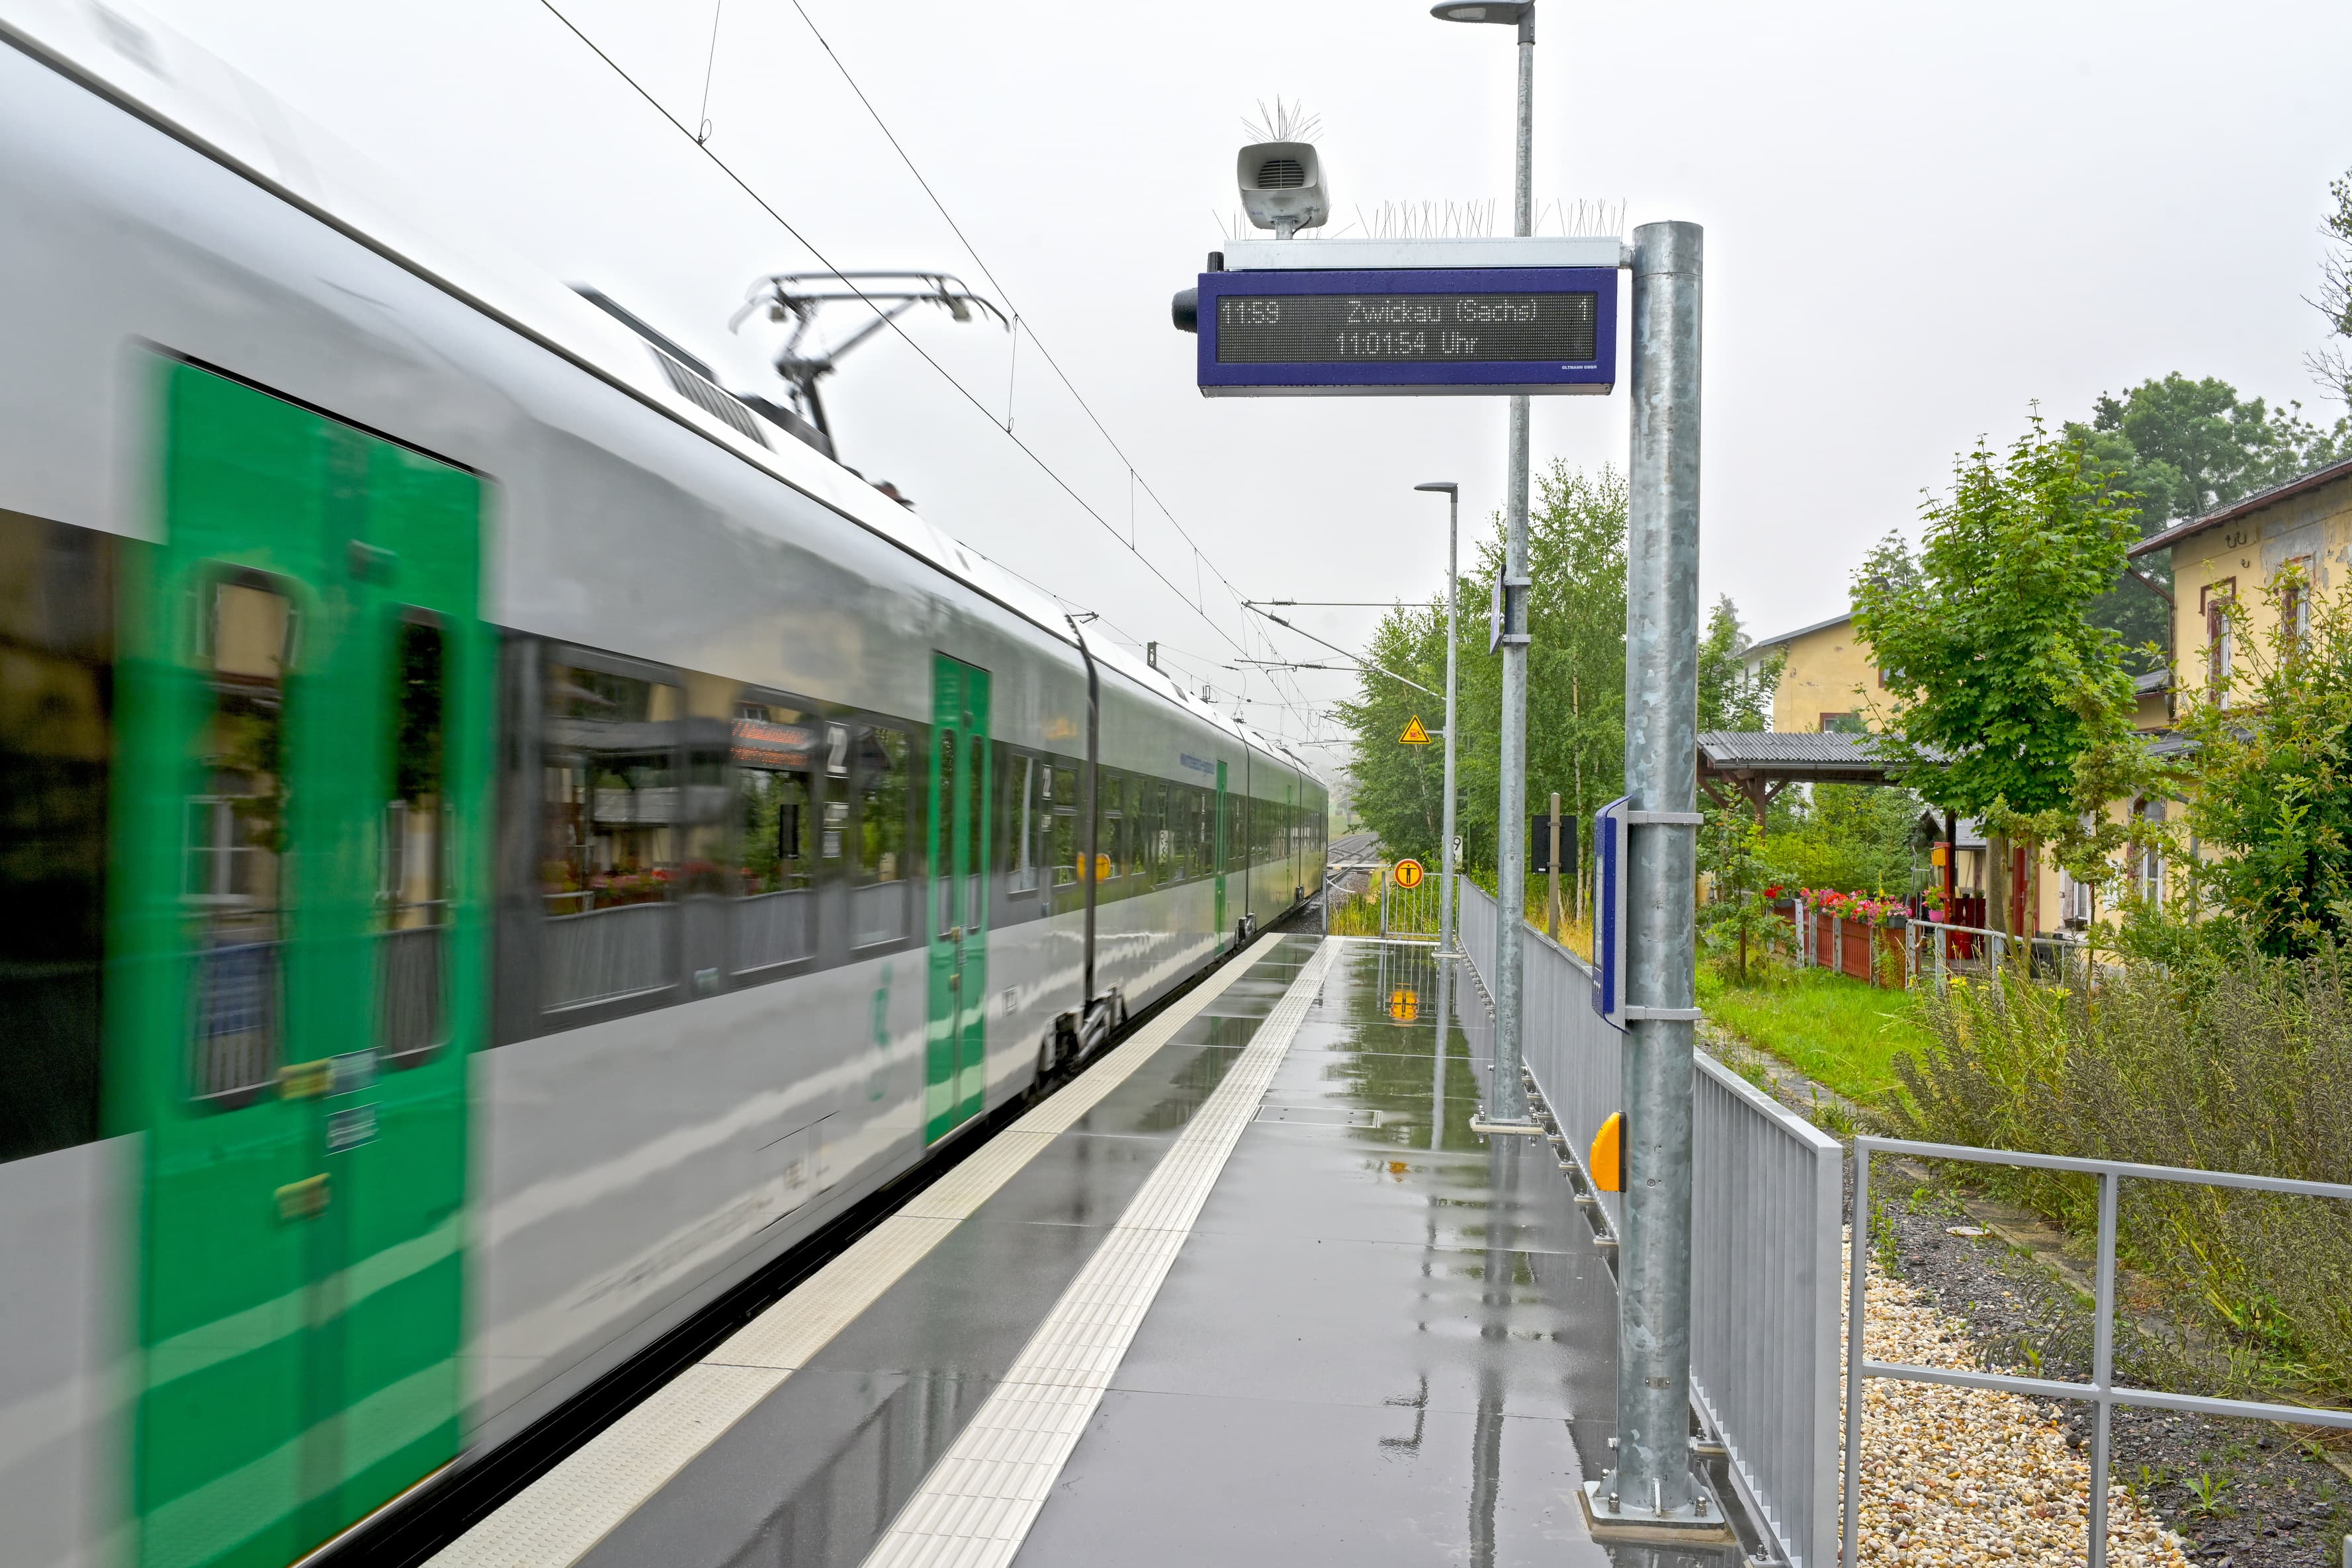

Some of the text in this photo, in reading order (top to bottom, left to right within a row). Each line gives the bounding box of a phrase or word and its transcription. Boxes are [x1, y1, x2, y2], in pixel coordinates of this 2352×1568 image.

[1348, 300, 1440, 322] Zwickau
[1457, 299, 1536, 322] (Sachs)
[1579, 298, 1587, 321] 1
[1336, 331, 1477, 354] 11:01:54 Uhr
